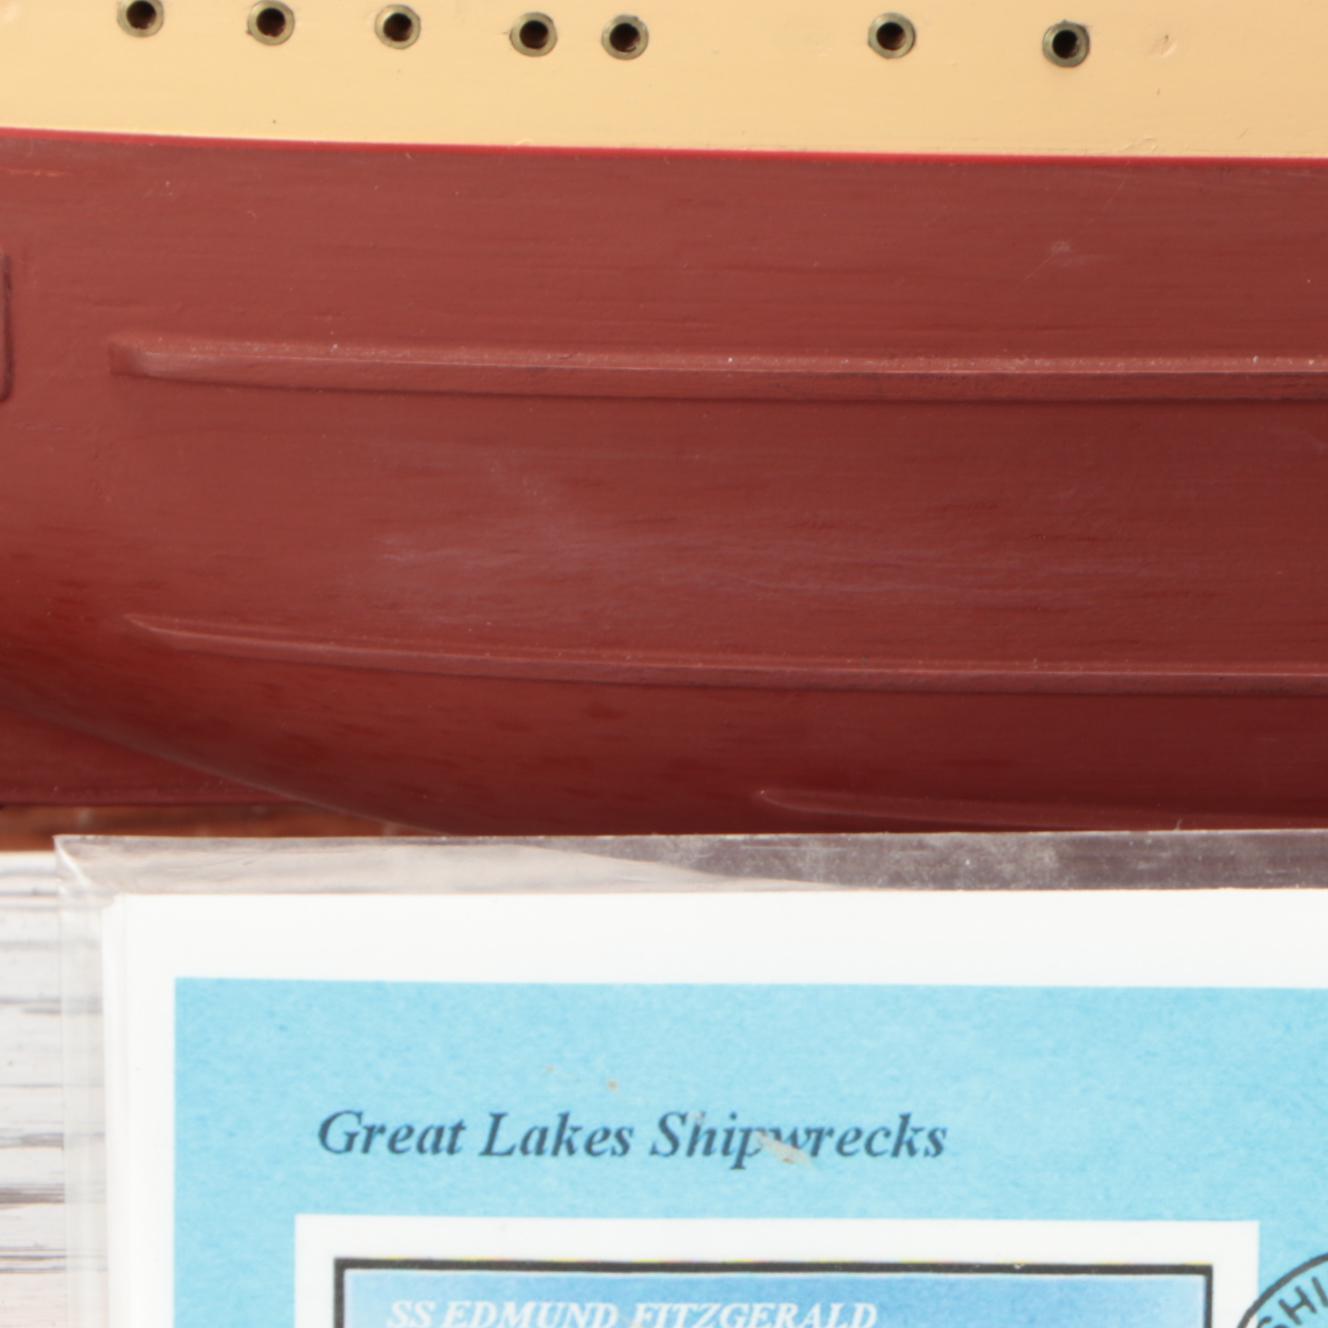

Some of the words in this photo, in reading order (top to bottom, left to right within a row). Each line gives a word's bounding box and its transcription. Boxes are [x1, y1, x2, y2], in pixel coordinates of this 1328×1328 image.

[316, 1110, 466, 1158] Great
[479, 1112, 633, 1158] Lakes
[649, 1111, 948, 1170] Shipwrecks
